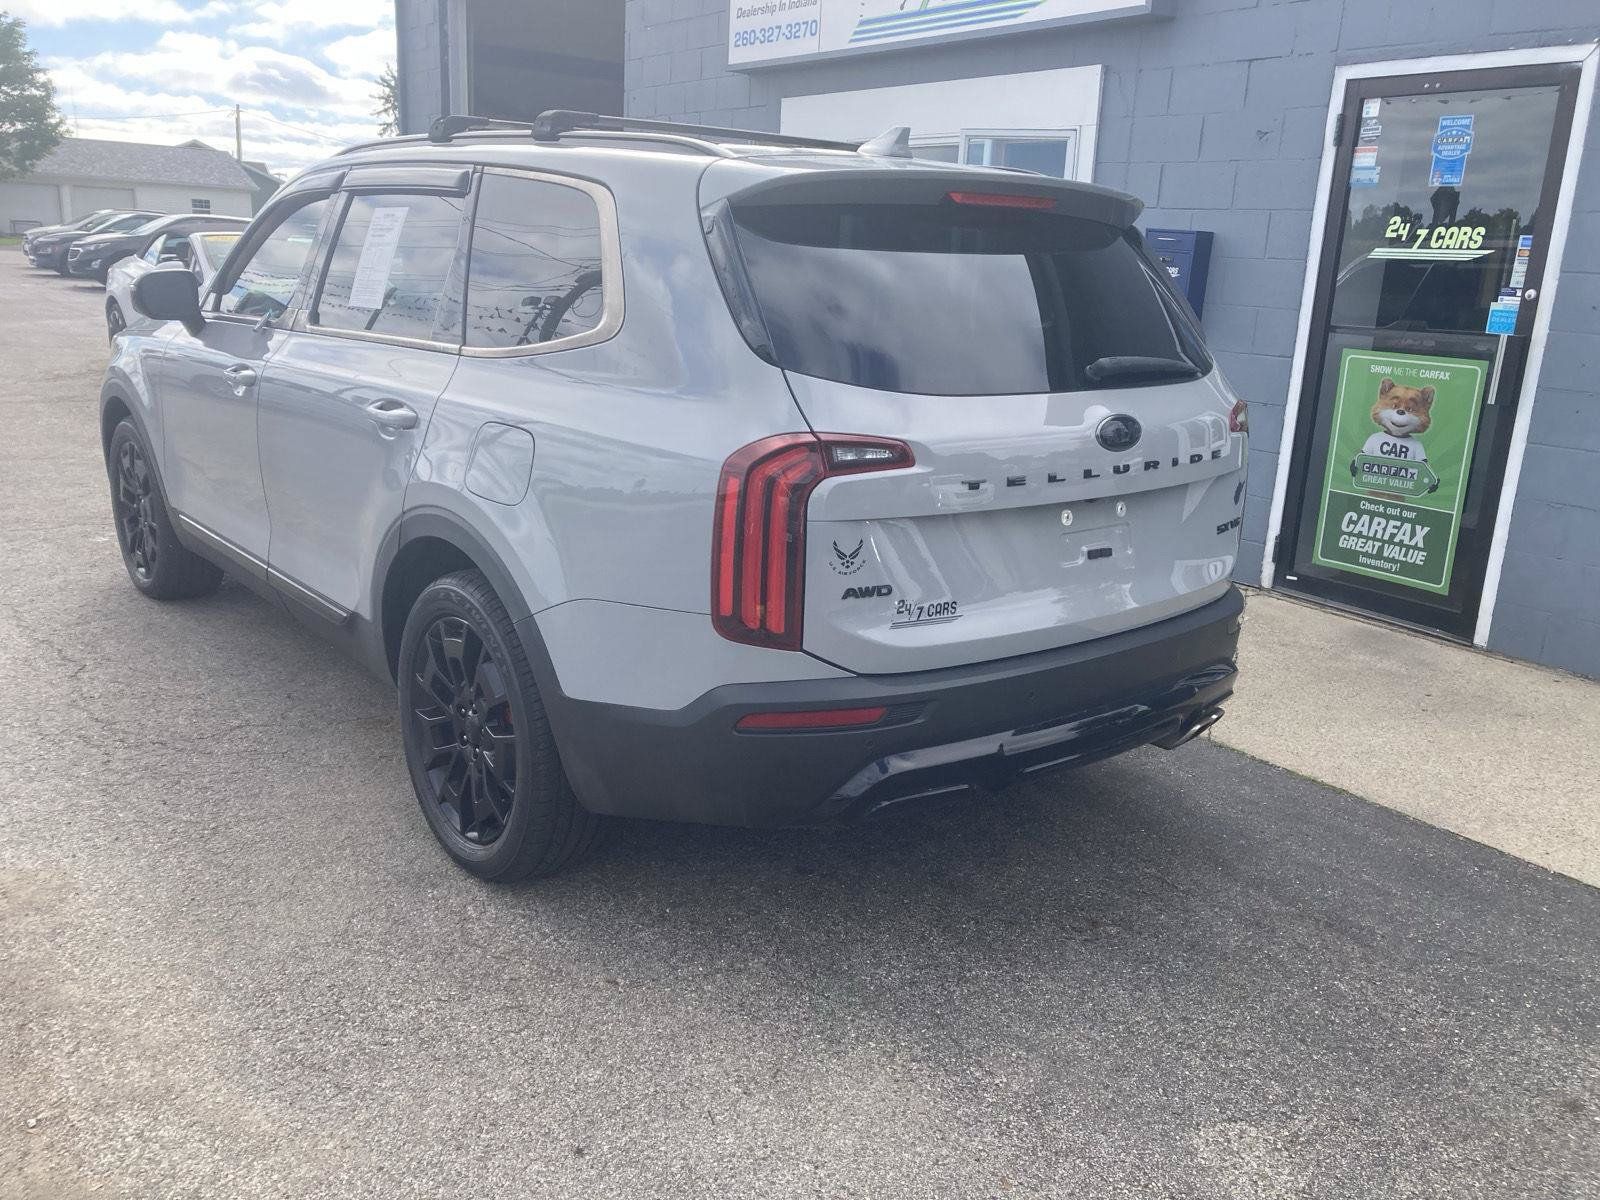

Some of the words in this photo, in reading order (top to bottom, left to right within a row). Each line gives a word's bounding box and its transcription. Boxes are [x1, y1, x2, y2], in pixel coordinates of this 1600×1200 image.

[736, 3, 777, 19] Dealership
[778, 1, 787, 12] In
[734, 19, 818, 48] 260-327-3270
[1441, 118, 1472, 127] WELCOME
[1430, 226, 1486, 249] CARS
[1370, 364, 1393, 375] SHOW
[1393, 367, 1405, 376] ME
[1405, 367, 1419, 377] THE
[1419, 369, 1451, 381] CARFAX
[1380, 441, 1410, 459] CAR
[961, 449, 1223, 490] TELLURIDE
[1362, 463, 1418, 481] CARFAX
[1362, 475, 1387, 487] GREAT
[1389, 478, 1415, 490] VALUE
[1360, 500, 1385, 513] Check
[1386, 507, 1401, 517] out
[1402, 510, 1417, 519] our
[1341, 511, 1431, 549] CARFAX
[1338, 534, 1383, 555] GREAT
[1383, 544, 1428, 566] VALUE
[1358, 554, 1401, 572] inventory!
[841, 584, 893, 600] AWD
[896, 599, 925, 621] 24/7
[926, 601, 958, 618] CARS
